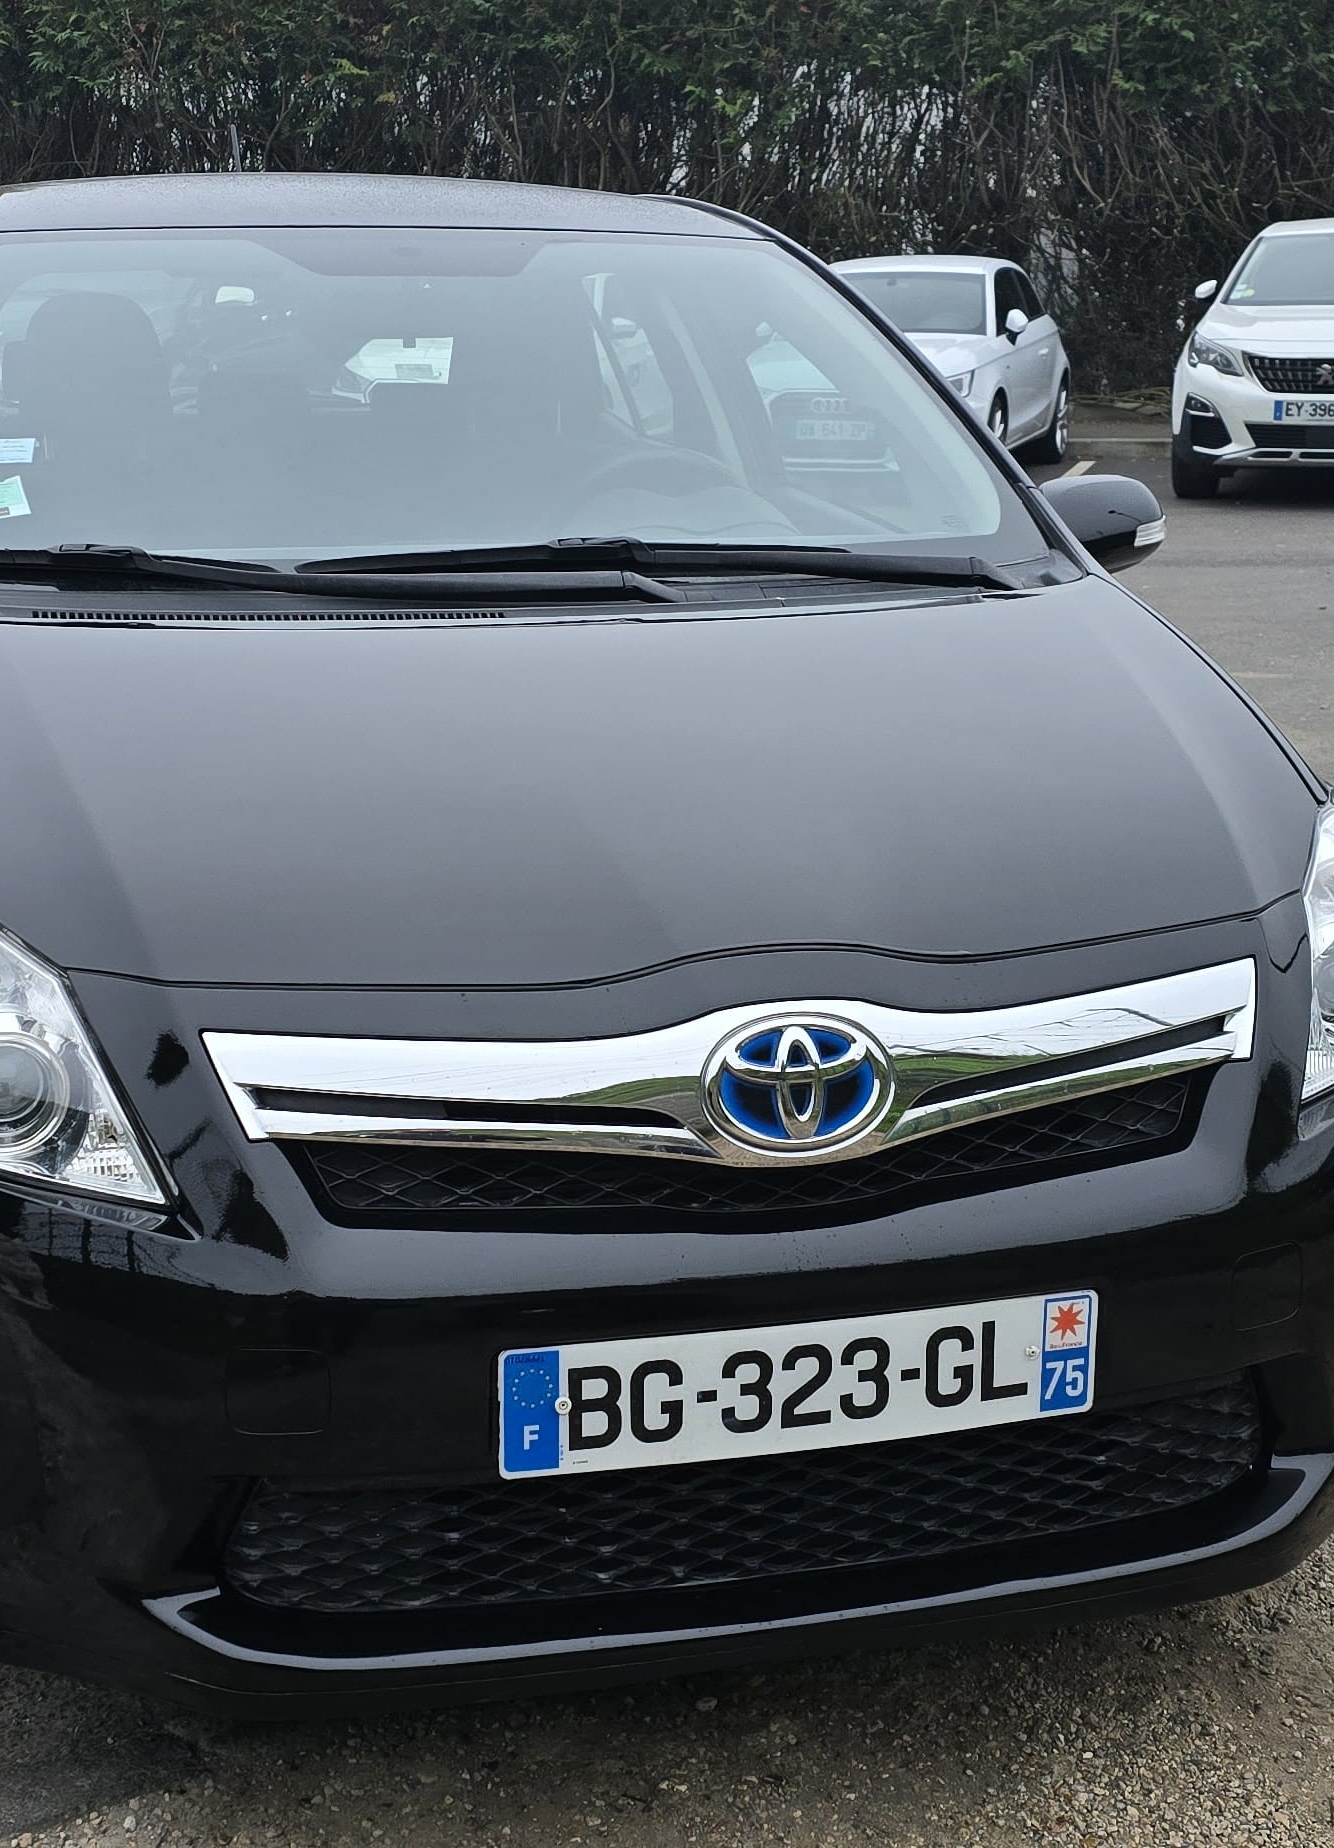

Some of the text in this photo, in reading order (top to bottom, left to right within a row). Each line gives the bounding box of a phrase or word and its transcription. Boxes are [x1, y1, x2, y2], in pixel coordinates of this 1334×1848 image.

[567, 1320, 1029, 1452] BG-323-GL
[1044, 1357, 1085, 1401] 75
[523, 1424, 540, 1451] F
